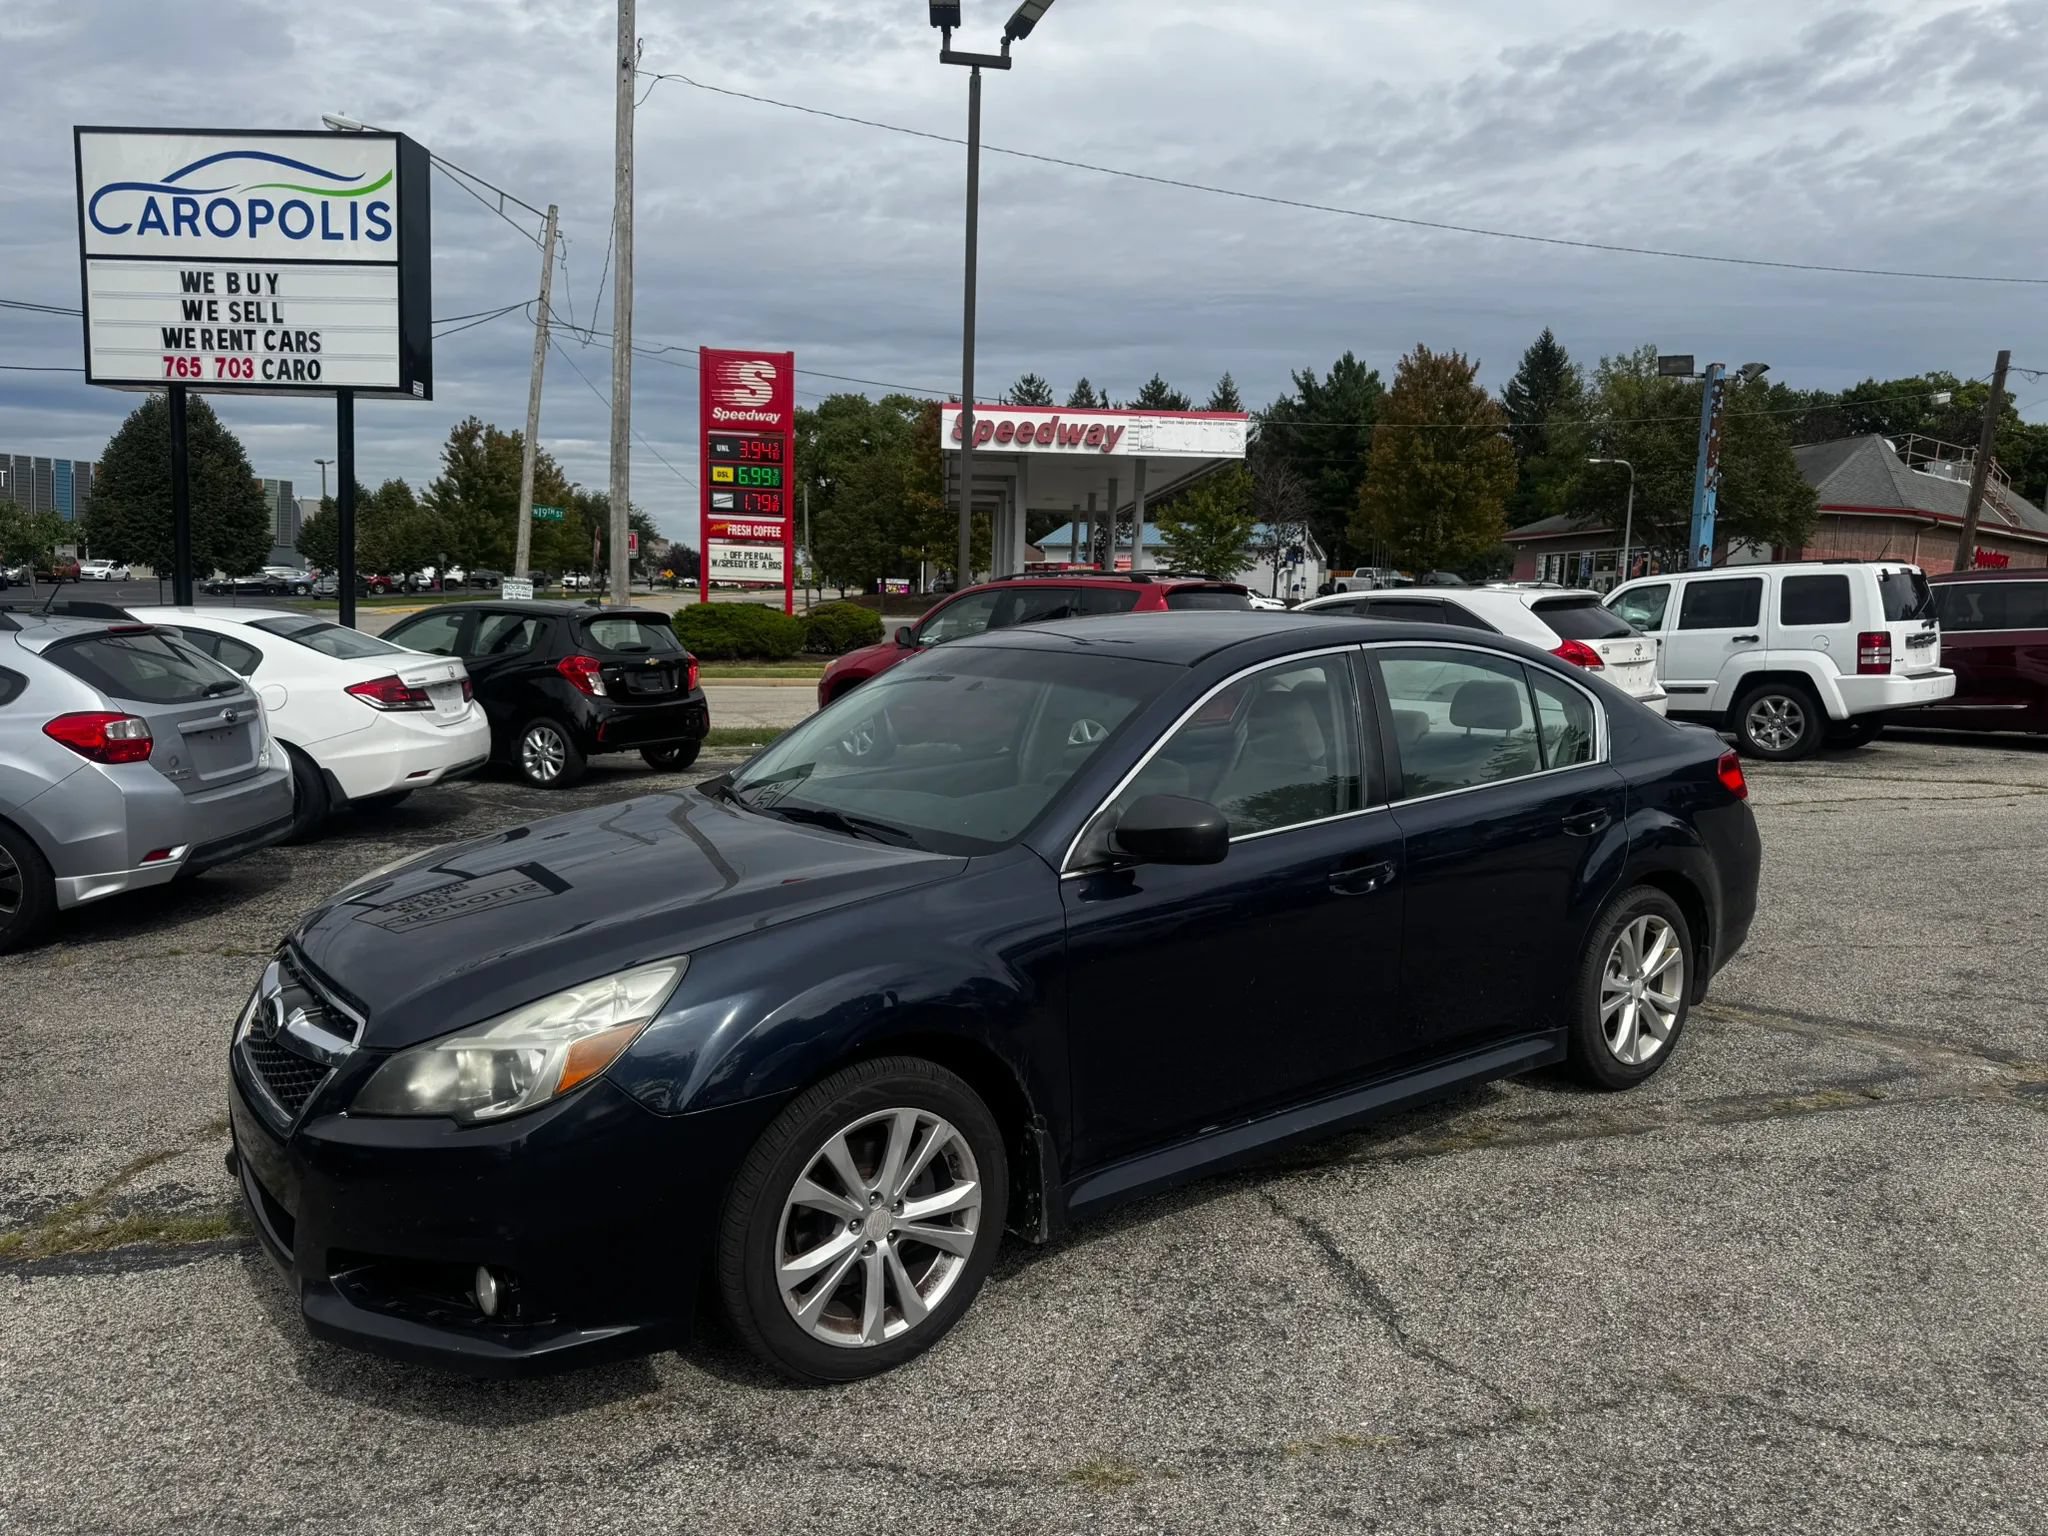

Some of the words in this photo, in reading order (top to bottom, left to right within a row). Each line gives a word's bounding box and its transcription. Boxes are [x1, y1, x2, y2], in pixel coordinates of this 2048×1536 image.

[89, 182, 392, 241] CAROPOLIS
[181, 271, 214, 293] WE
[227, 272, 279, 294] BUY
[182, 300, 218, 321] WE
[229, 301, 283, 323] SELL
[162, 327, 196, 349] WE
[201, 328, 256, 350] RENT
[264, 330, 320, 352] CARS
[163, 356, 201, 377] 765
[215, 357, 254, 378] 703
[262, 358, 320, 380] CARO
[712, 406, 781, 424] Speedway
[716, 444, 730, 452] UNL
[739, 441, 771, 458] 3.94
[738, 466, 771, 486] 6.99
[745, 493, 771, 512] 1.79
[727, 524, 751, 536] FRESH
[753, 525, 781, 537] COFFEE
[729, 551, 742, 559] OFF
